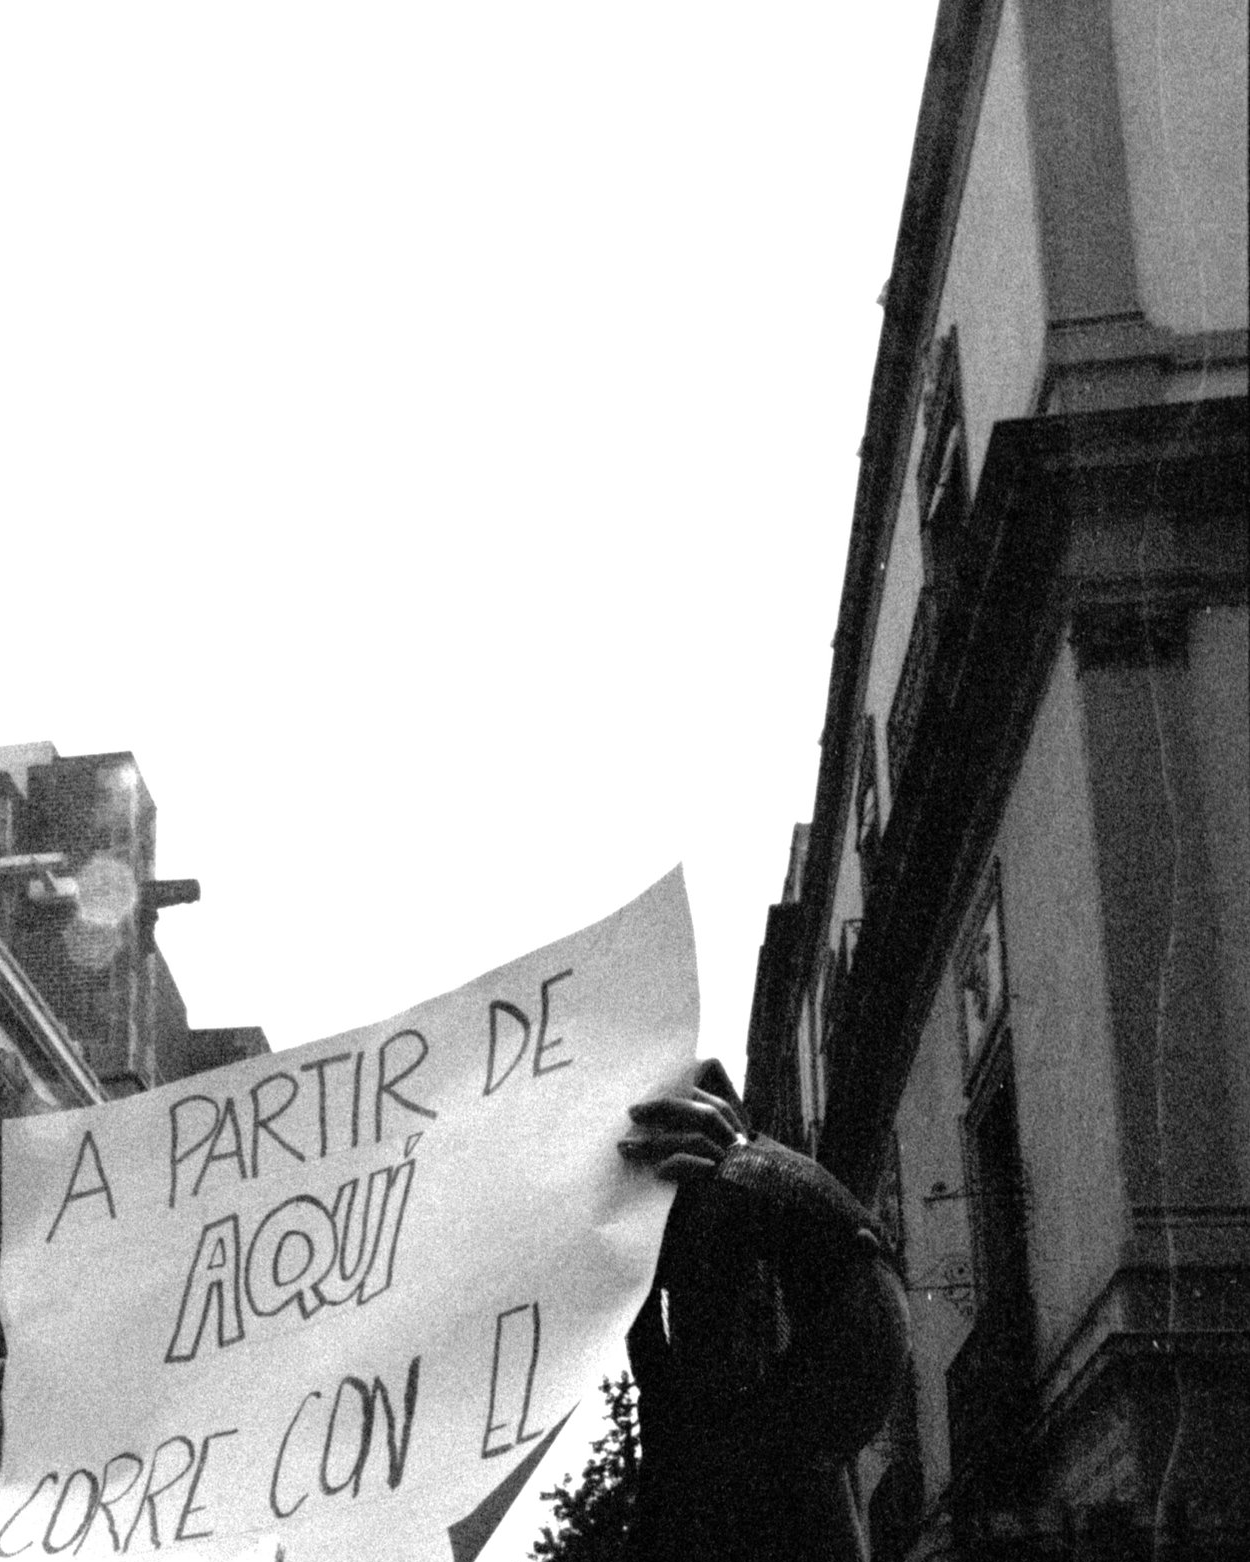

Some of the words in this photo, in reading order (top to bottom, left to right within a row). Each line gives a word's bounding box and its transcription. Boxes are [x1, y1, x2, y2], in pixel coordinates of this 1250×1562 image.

[46, 1130, 117, 1244] A
[169, 1030, 438, 1208] PARTIR
[482, 967, 574, 1097] DE
[163, 1130, 425, 1365] AQUÍ
[269, 1354, 422, 1519] CON
[480, 1300, 546, 1460] EL
